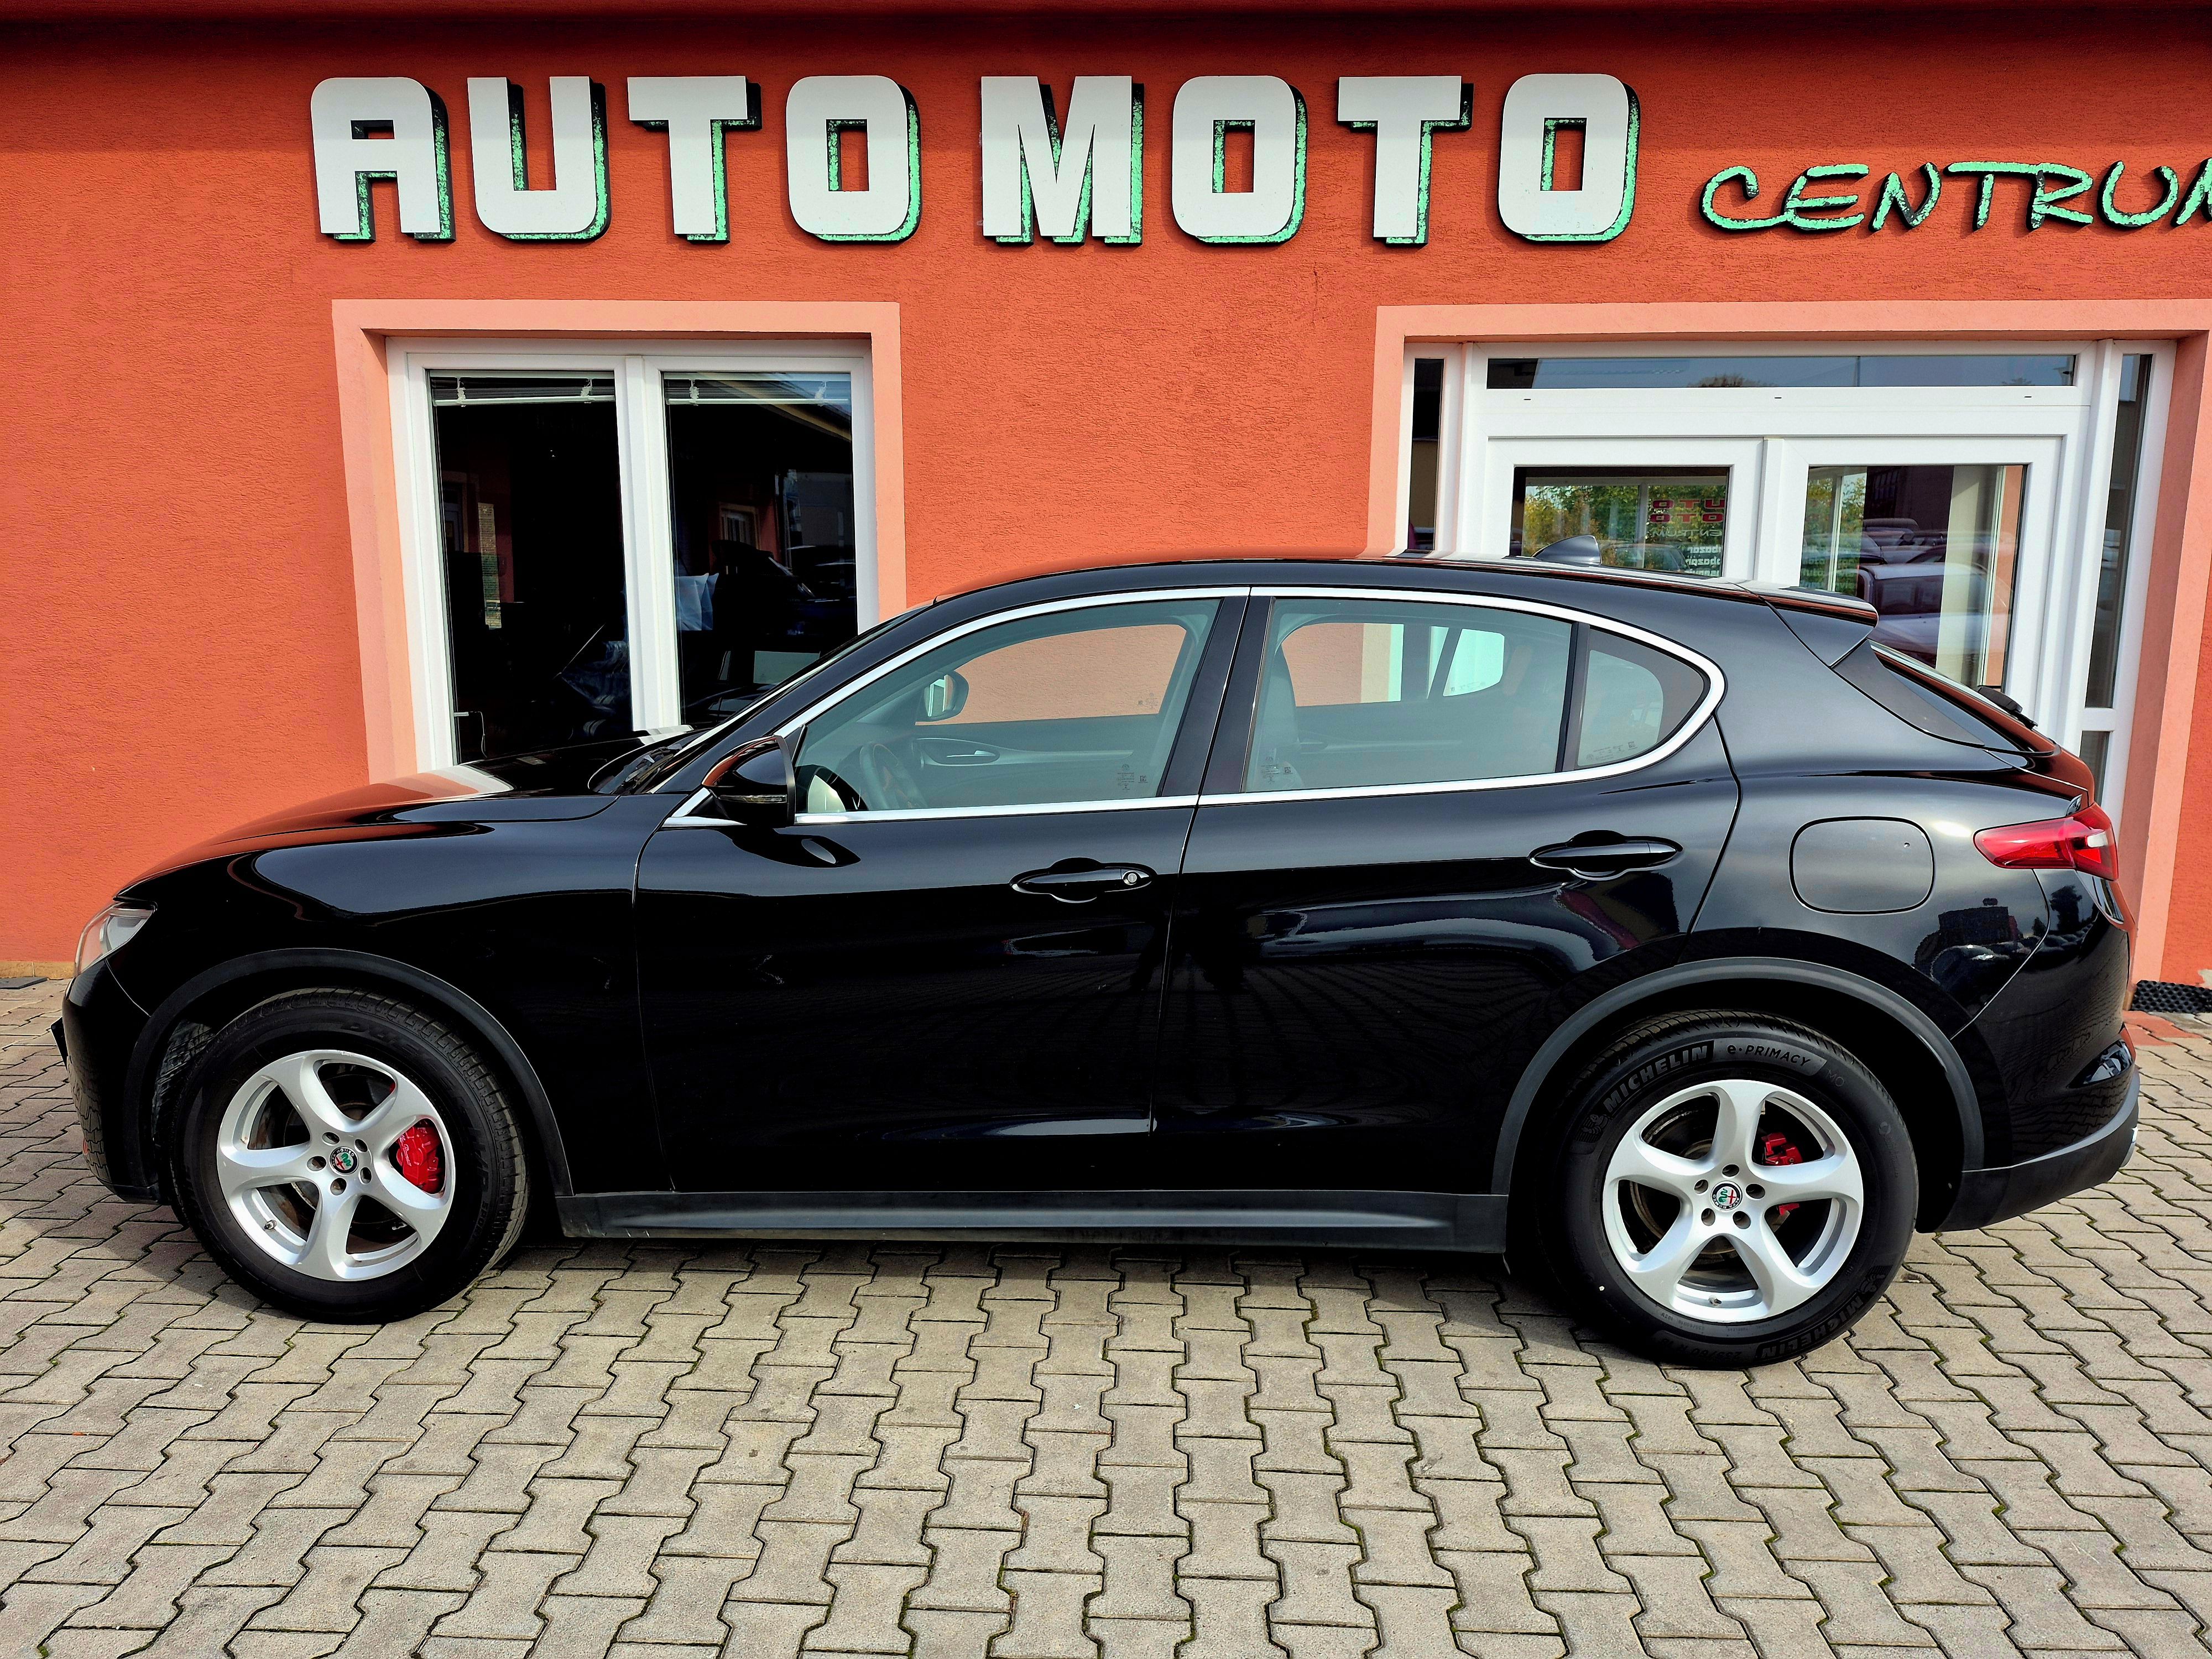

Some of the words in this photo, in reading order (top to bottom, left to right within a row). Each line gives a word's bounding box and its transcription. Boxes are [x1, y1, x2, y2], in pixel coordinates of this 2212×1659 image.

[310, 75, 920, 242] AUTO
[981, 74, 1640, 244] MOTO
[1603, 1045, 1708, 1113] MICHELIN
[1762, 1296, 1864, 1357] MICHELIN
